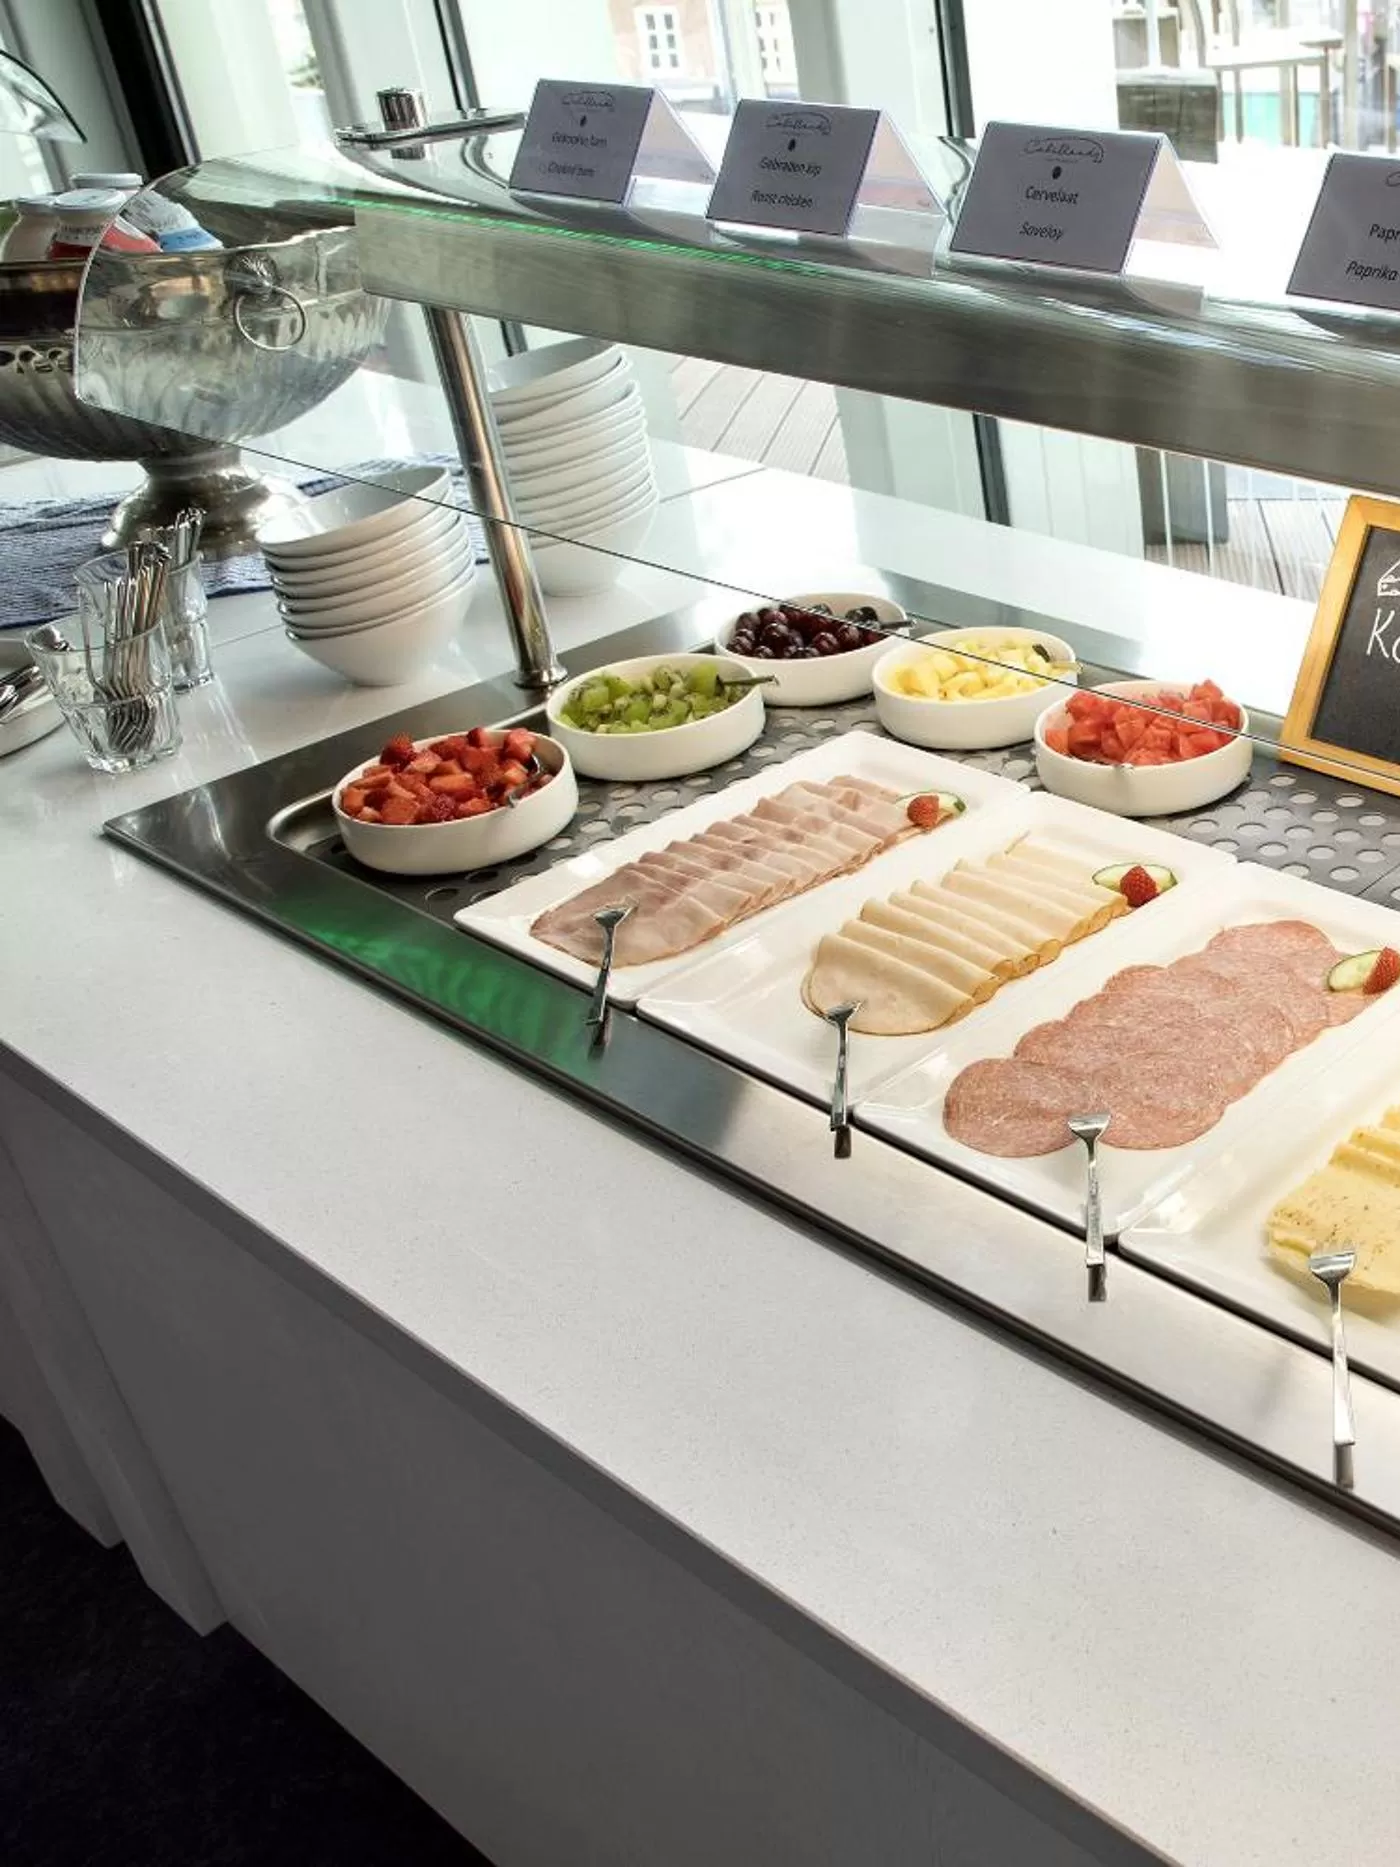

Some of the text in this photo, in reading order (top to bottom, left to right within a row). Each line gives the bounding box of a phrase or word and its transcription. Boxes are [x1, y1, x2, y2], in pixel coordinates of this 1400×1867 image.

[1025, 185, 1080, 205] Cervelaat
[1019, 221, 1064, 241] Saveloy
[1345, 260, 1398, 284] Paprika
